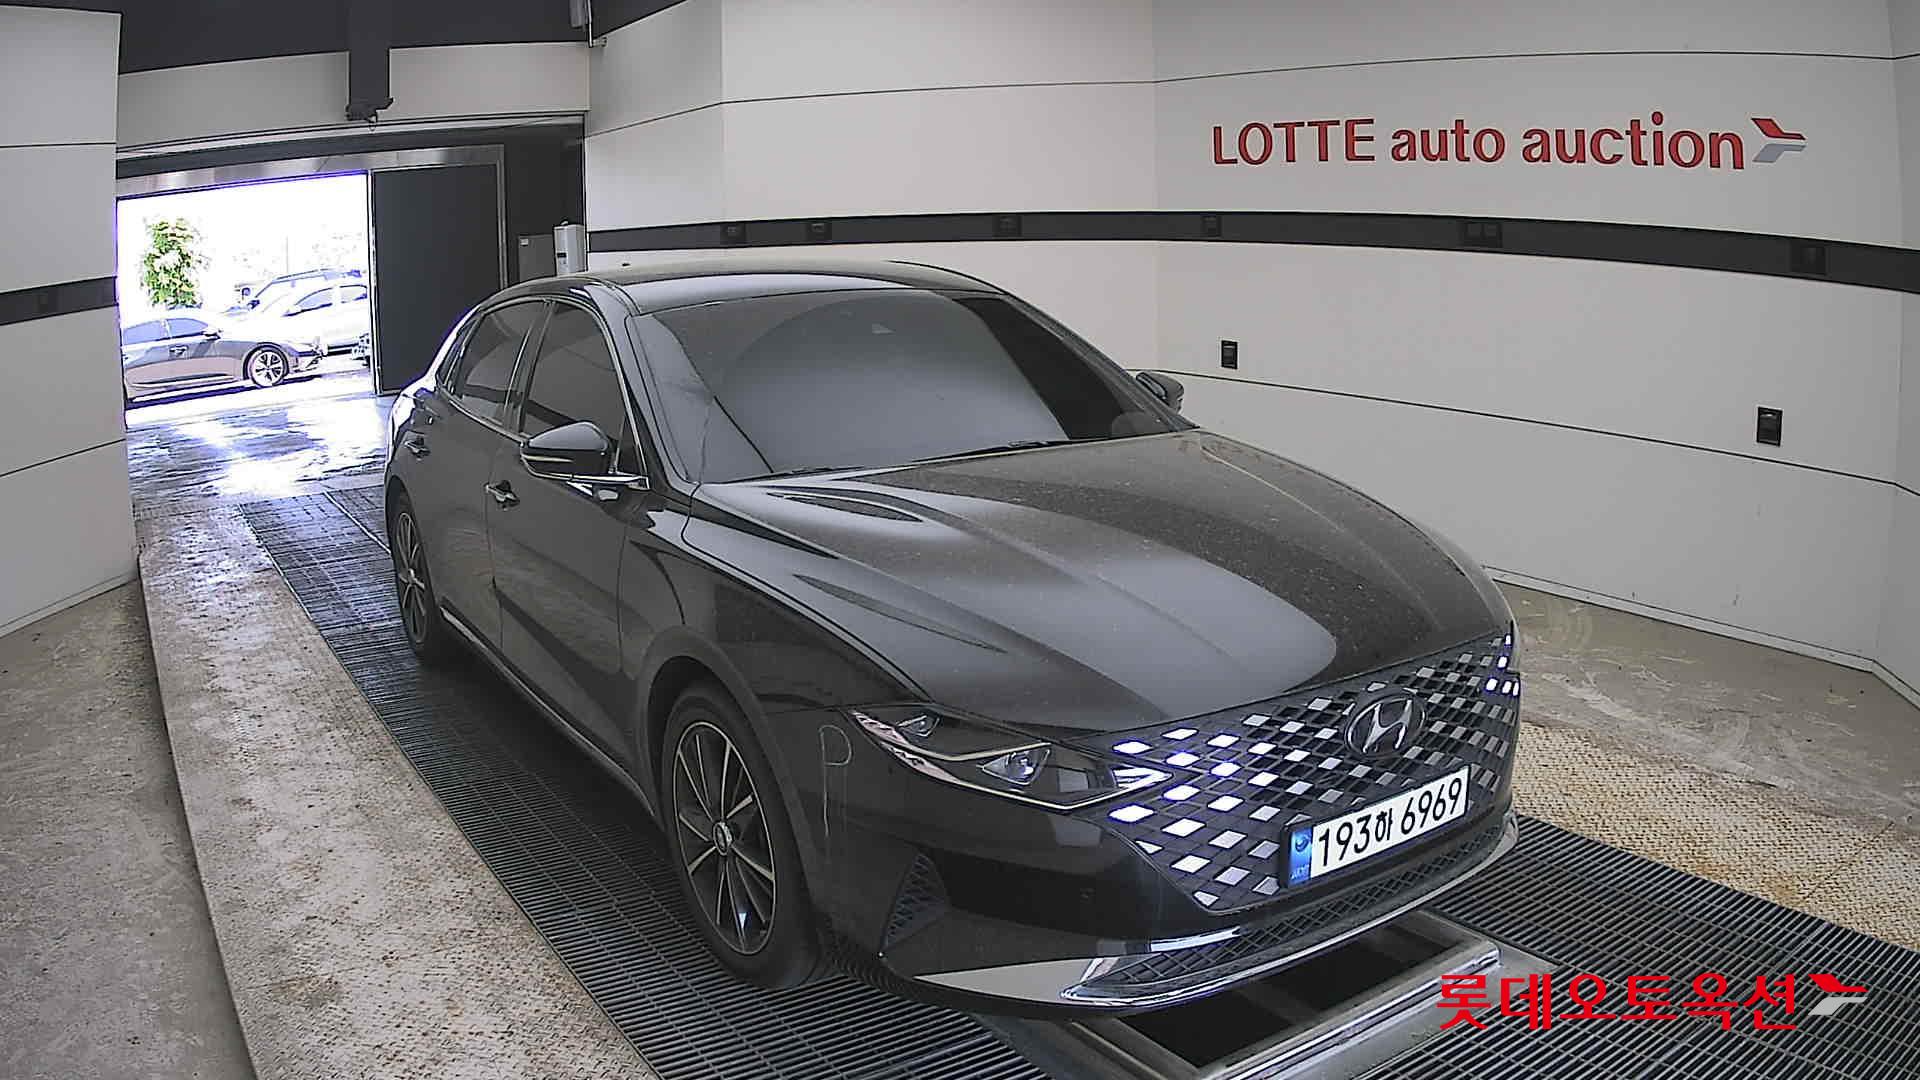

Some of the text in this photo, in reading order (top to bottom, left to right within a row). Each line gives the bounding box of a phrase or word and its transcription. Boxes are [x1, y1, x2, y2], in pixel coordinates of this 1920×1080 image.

[1212, 111, 1745, 170] LOTTE auto auction
[1318, 777, 1462, 867] 193하 6969
